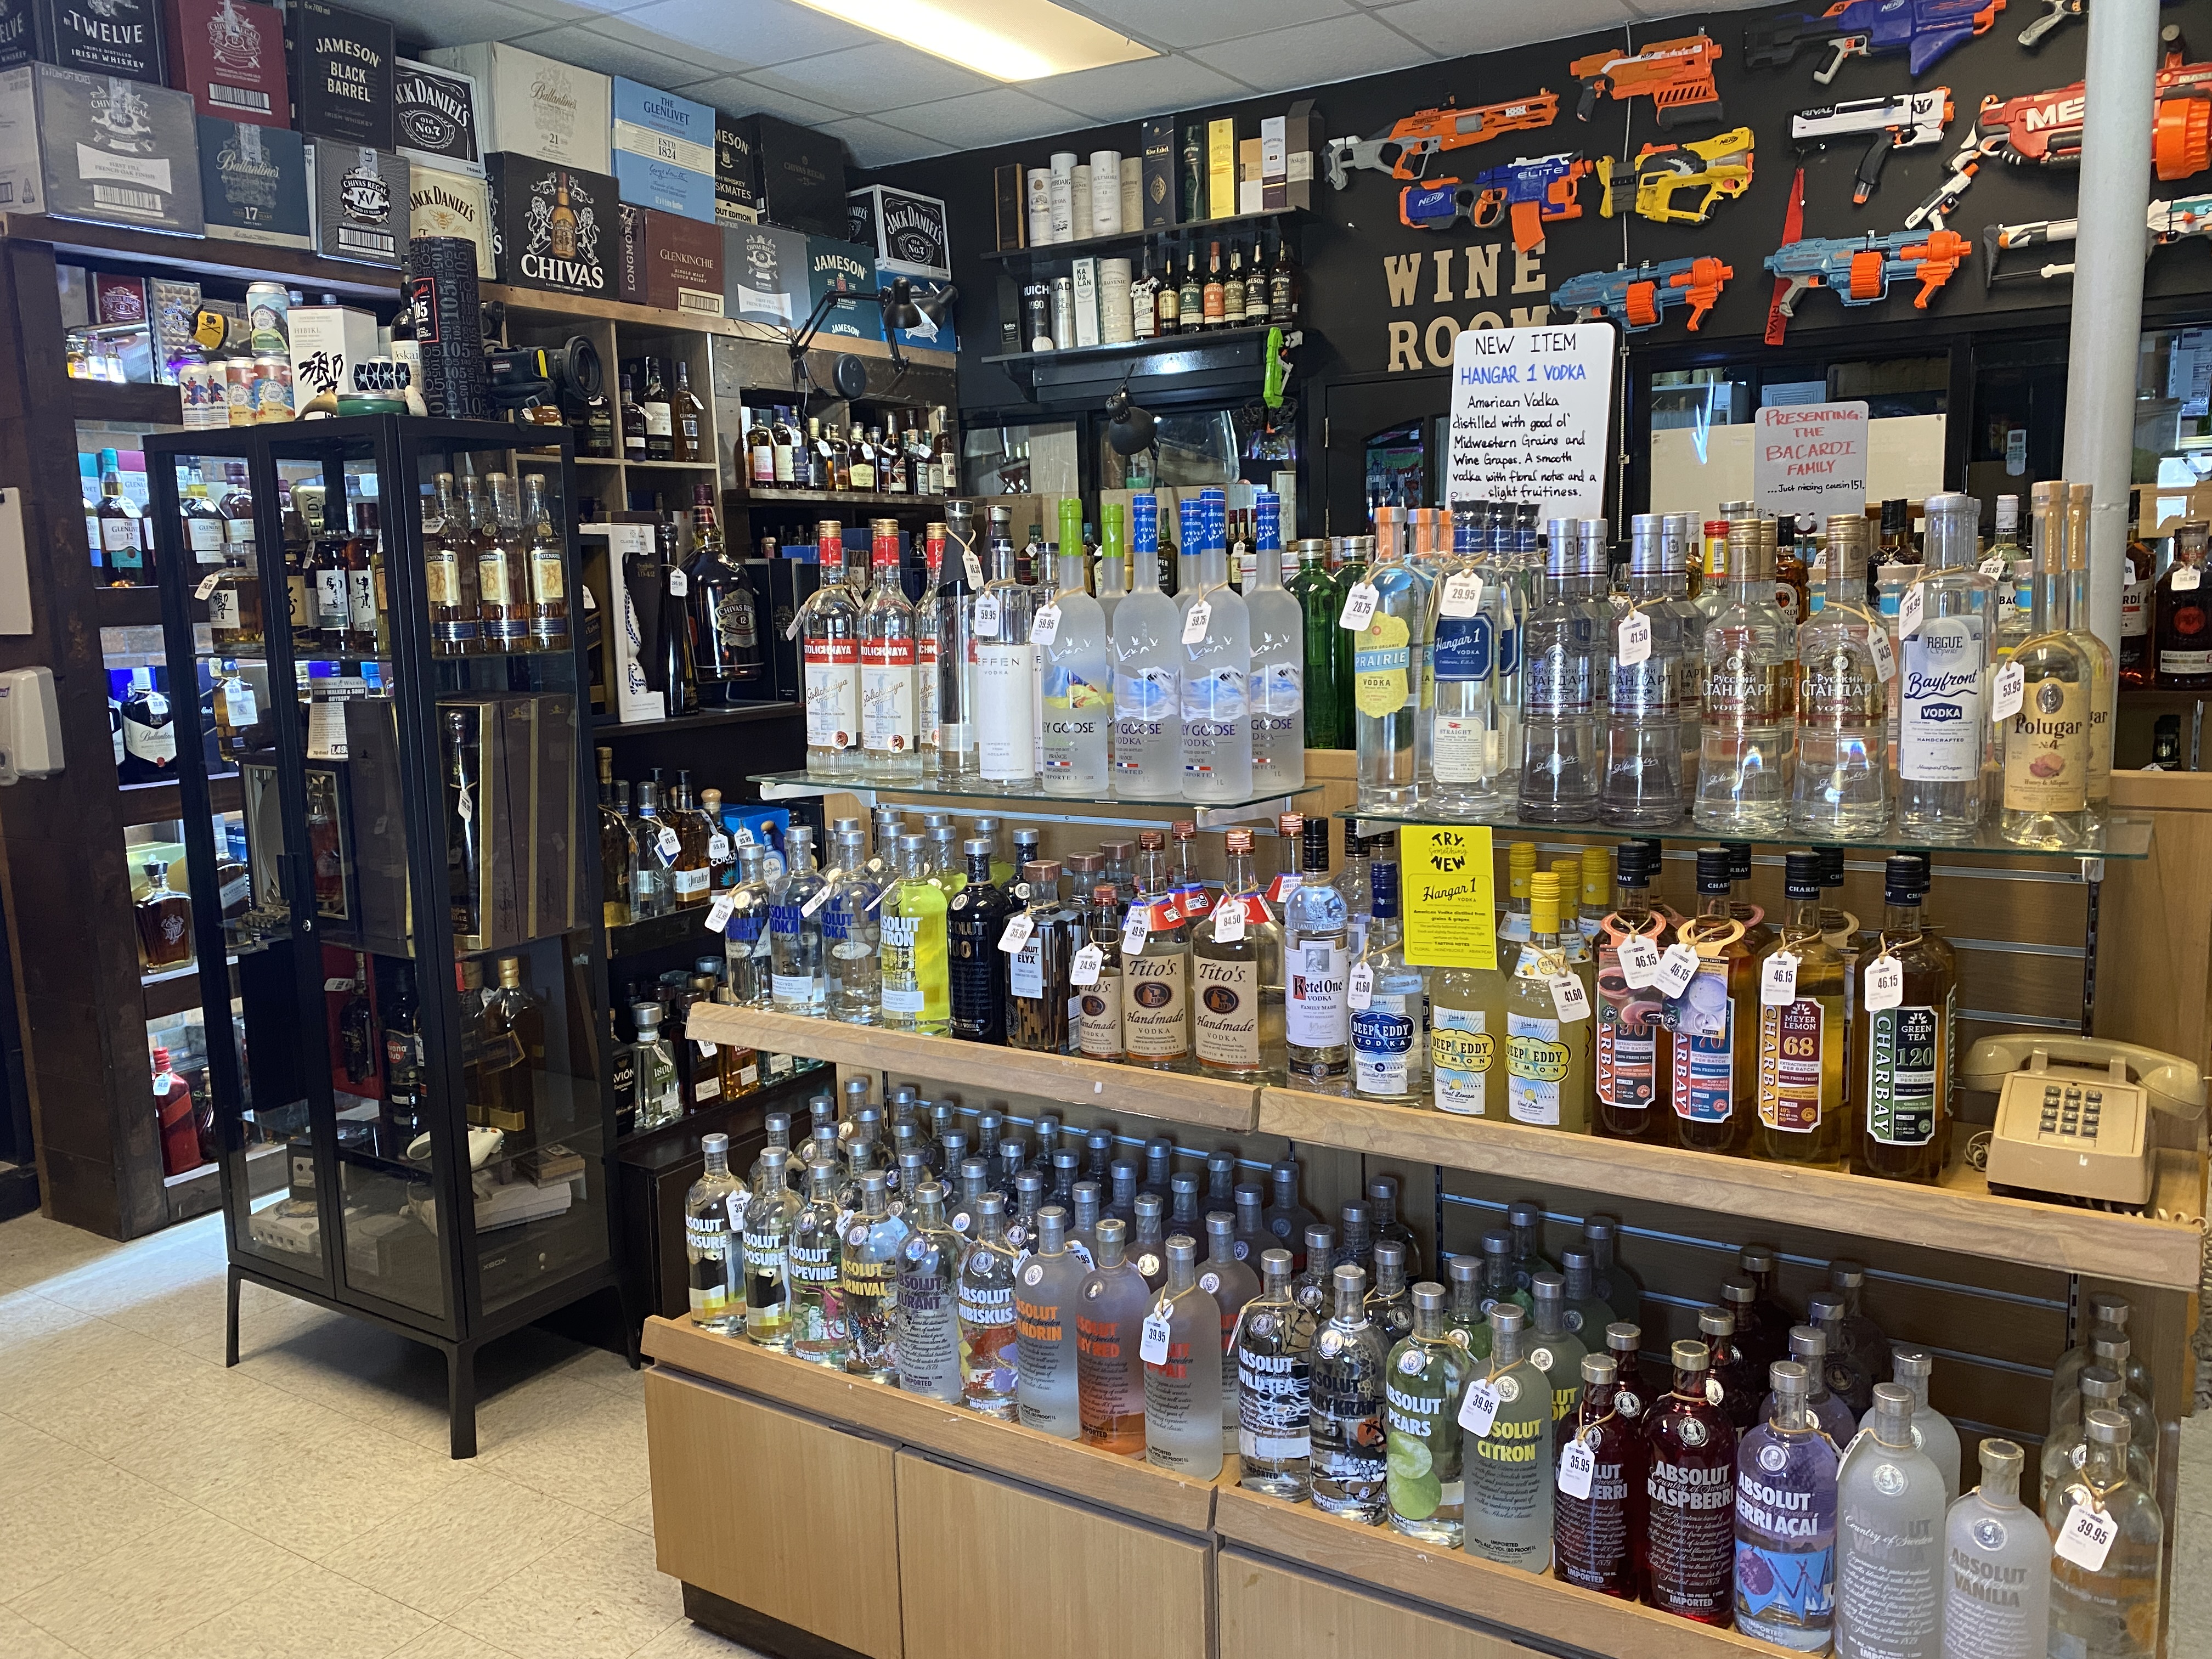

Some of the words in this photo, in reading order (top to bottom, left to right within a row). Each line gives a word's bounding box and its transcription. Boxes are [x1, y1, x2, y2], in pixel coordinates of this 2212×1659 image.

[69, 9, 144, 44] TWELVE
[71, 48, 98, 60] IRISH
[101, 54, 145, 69] WHISKEY
[316, 38, 380, 67] JAMESON
[331, 61, 366, 83] BLACK
[328, 78, 371, 103] BARREL
[531, 81, 577, 109] Ballantine's
[415, 77, 470, 127] DANIEL'S
[660, 97, 674, 108] THE
[644, 101, 690, 126] GLENLIVET
[1802, 107, 1833, 117] RIVAL
[549, 133, 559, 144] 21
[1720, 136, 1738, 145] NERF
[658, 147, 676, 161] 1824
[216, 148, 279, 178] Ballantine's
[1517, 167, 1564, 179] ELITE
[343, 179, 366, 188] CHIVAS
[366, 181, 387, 195] REGAL
[410, 190, 433, 211] JACK
[433, 185, 475, 222] DANIEL'S
[1418, 192, 1444, 206] NERF
[245, 206, 257, 220] 17
[728, 210, 751, 223] EDITION
[887, 211, 907, 235] JACK
[907, 205, 944, 245] DANIEL'S
[660, 249, 714, 269] GLENKINCHIE
[814, 254, 866, 280] JAMESON
[521, 253, 603, 289] CHIVAS
[1384, 239, 1546, 307] WINE
[1029, 300, 1044, 310] 1990
[1475, 335, 1515, 355] NEW
[1531, 332, 1576, 353] ITEM
[1461, 364, 1520, 385] HANGAR
[1527, 364, 1537, 381] 1
[1543, 364, 1586, 380] VODKA
[1468, 396, 1520, 408] American
[1524, 392, 1560, 407] Vodka
[1453, 414, 1496, 429] distilled
[1501, 415, 1526, 428] with
[1530, 413, 1552, 431] good
[1454, 435, 1516, 449] Midwestern
[1522, 434, 1559, 448] Grains
[1566, 430, 1585, 445] and
[1793, 427, 1825, 438] THE
[1765, 441, 1857, 461] BACARDI
[1453, 453, 1479, 466] Wine
[1484, 453, 1521, 469] Grapes.
[1525, 453, 1533, 463] A
[1537, 451, 1572, 463] smooth
[1787, 460, 1836, 476] FAMILY
[1453, 469, 1482, 482] vodka
[1486, 470, 1506, 482] with
[1509, 469, 1537, 482] floral
[1541, 469, 1564, 482] notes
[1568, 469, 1584, 482] and
[1589, 473, 1596, 482] a
[1488, 485, 1517, 500] slight
[1520, 485, 1582, 499] fruitiness.
[1798, 483, 1823, 494] missing
[1850, 479, 1865, 490] 151.
[1452, 588, 1475, 600] 29.95
[981, 610, 996, 620] 59.95
[1355, 601, 1370, 614] 28.75
[1906, 596, 1921, 617] 39.95
[1039, 619, 1054, 629] 59.95
[1192, 615, 1206, 626] 59.75
[1436, 635, 1472, 652] Hangar
[1474, 628, 1480, 642] 1
[1630, 630, 1647, 644] 41.50
[1927, 636, 1963, 648] ROGUE
[1356, 652, 1406, 668] PRAIRIE
[1909, 669, 1977, 693] Bayfront
[2003, 679, 2021, 698] 53.95
[1923, 708, 1961, 718] VODKA
[1053, 722, 1094, 734] GOOSE
[2015, 713, 2082, 738] Polugar
[1432, 832, 1465, 847] TRY
[1429, 847, 1468, 855] Something
[1431, 855, 1465, 872] NEW
[1422, 882, 1469, 902] Hangar
[1470, 878, 1477, 893] 1
[1224, 915, 1240, 926] 84.50
[1010, 928, 1026, 940] 35.90
[1132, 926, 1145, 938] 49.95
[1018, 954, 1035, 964] ELYX
[1080, 961, 1097, 970] 24.95
[1635, 953, 1657, 969] 46.15
[1671, 963, 1691, 981] 46.15
[1774, 970, 1793, 983] 46.15
[1293, 975, 1323, 998] Ketel
[1324, 982, 1342, 993] One
[1355, 981, 1370, 993] 41.60
[1878, 975, 1898, 989] 46.15
[1565, 989, 1583, 1002] 41.60
[1127, 1008, 1183, 1024] Handmade
[1197, 1014, 1254, 1032] Handmade
[1784, 1015, 1816, 1024] MEYER
[1353, 1022, 1374, 1036] DEEP
[1382, 1024, 1409, 1037] EDDY
[1784, 1022, 1816, 1030] LEMON
[1901, 1024, 1932, 1034] GREEN
[1357, 1037, 1406, 1047] VODKA
[1908, 1032, 1927, 1041] TEA
[1433, 1037, 1451, 1051] DEEP
[1461, 1042, 1488, 1054] EDDY
[1784, 1036, 1814, 1057] 68
[1762, 1004, 1778, 1120] CHARBAY
[1897, 1047, 1933, 1066] 120
[1874, 1015, 1892, 1133] CHARBAY
[959, 1285, 1011, 1305] ABSOLUT
[959, 1306, 1013, 1324] HIBISKUS
[1149, 1328, 1165, 1343] 39.95
[1239, 1345, 1294, 1373] ABSOLUT
[1386, 1382, 1442, 1415] ABSOLUT
[1474, 1394, 1494, 1414] 39.95
[1388, 1408, 1431, 1437] PEARS
[1477, 1437, 1536, 1462] CITRON
[1571, 1454, 1590, 1473] 35.95
[1655, 1460, 1730, 1485] ABSOLUT
[1647, 1477, 1734, 1510] RASPBERRI
[1738, 1471, 1811, 1511] ABSOLUT
[1774, 1513, 1819, 1538] AÇAÍ
[2077, 1519, 2108, 1545] 39.95
[1952, 1547, 2028, 1583] ABSOLUT
[1670, 1594, 1713, 1607] IMPORTED
